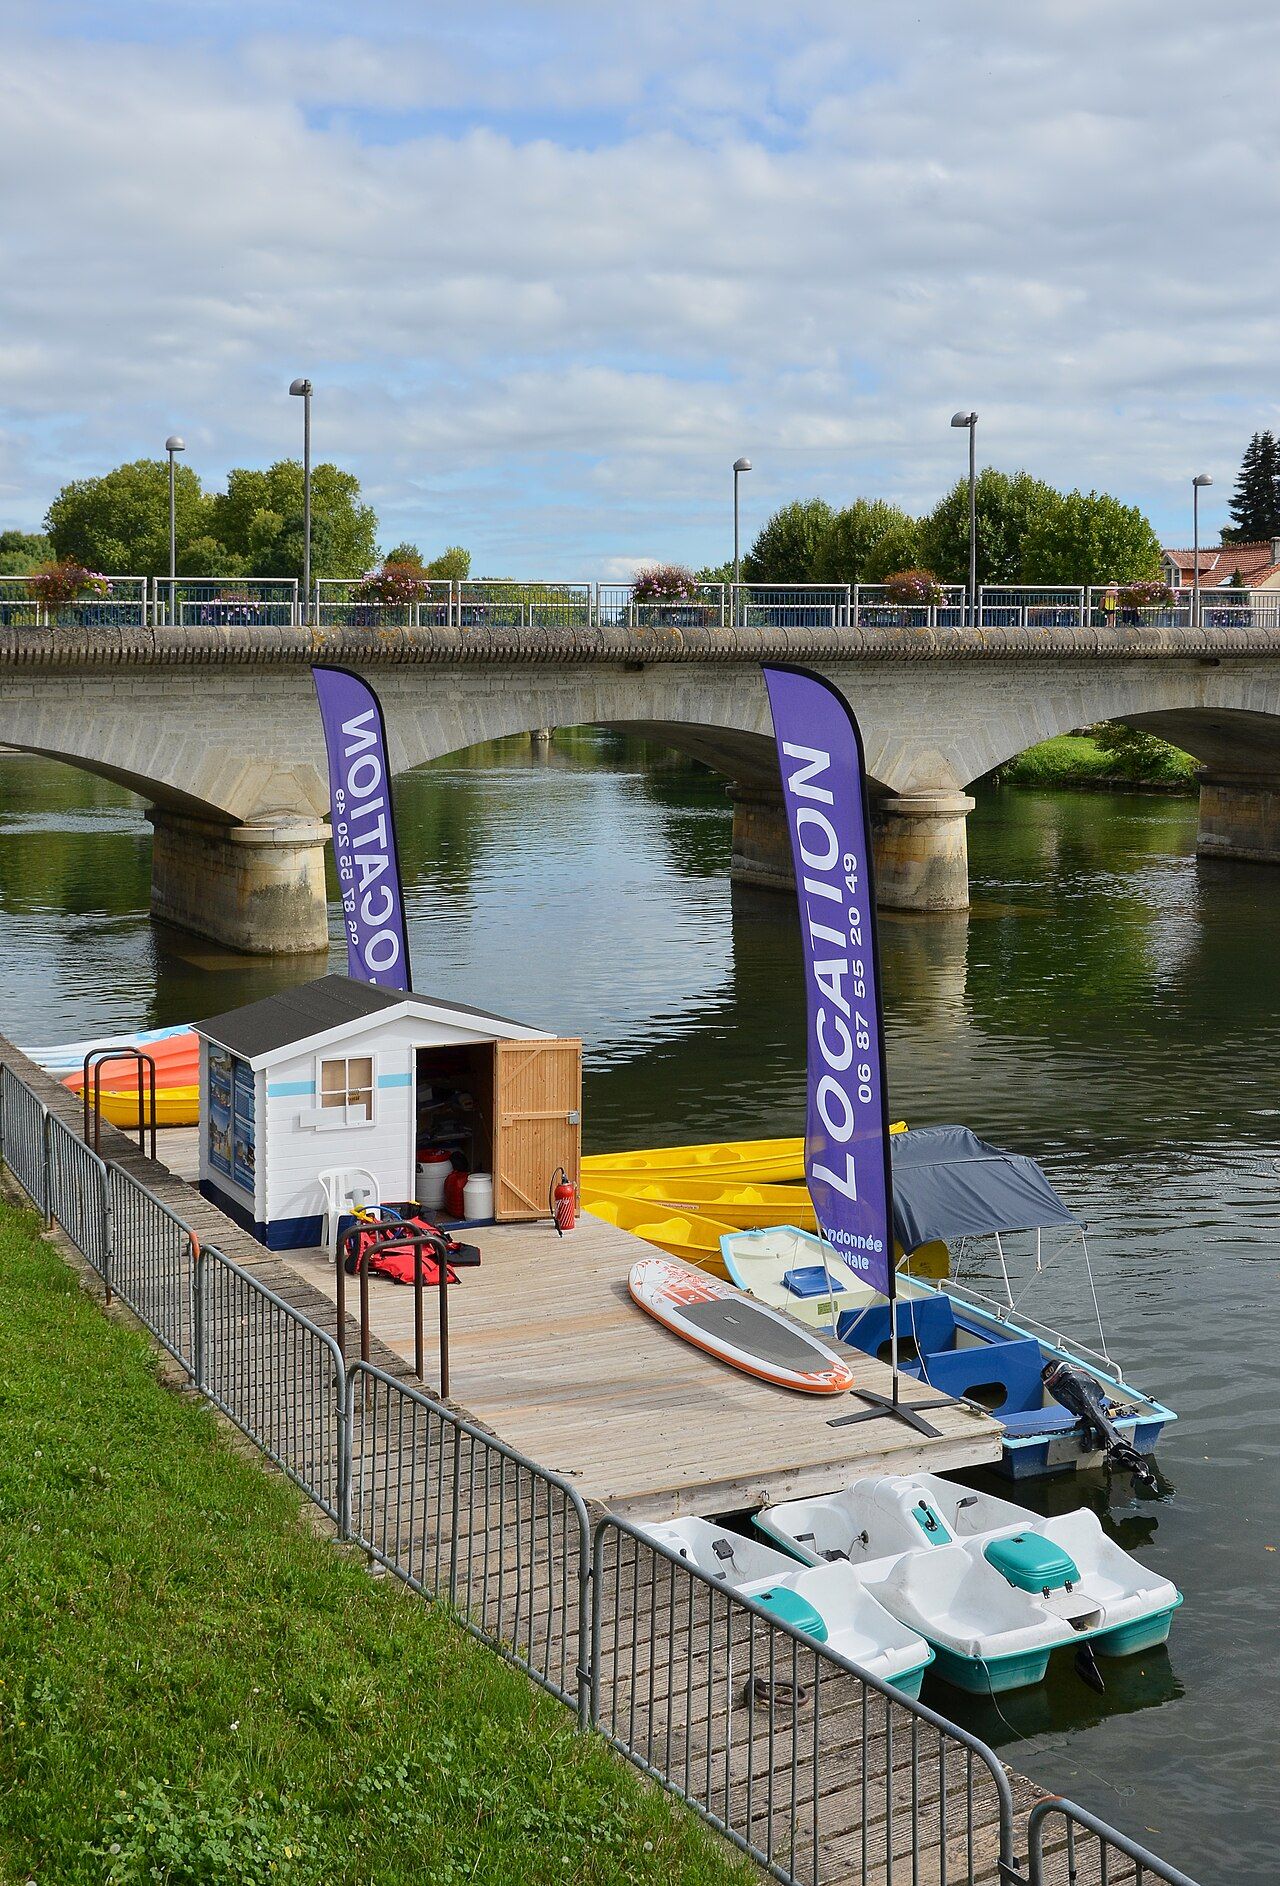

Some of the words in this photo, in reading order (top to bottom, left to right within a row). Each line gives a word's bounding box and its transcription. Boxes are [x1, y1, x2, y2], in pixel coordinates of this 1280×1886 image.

[843, 853, 858, 894] 49
[848, 906, 862, 947] 20
[782, 741, 857, 1202] LOCATION
[852, 959, 866, 999] 55
[855, 1010, 870, 1051] 87
[857, 1063, 872, 1104] 06
